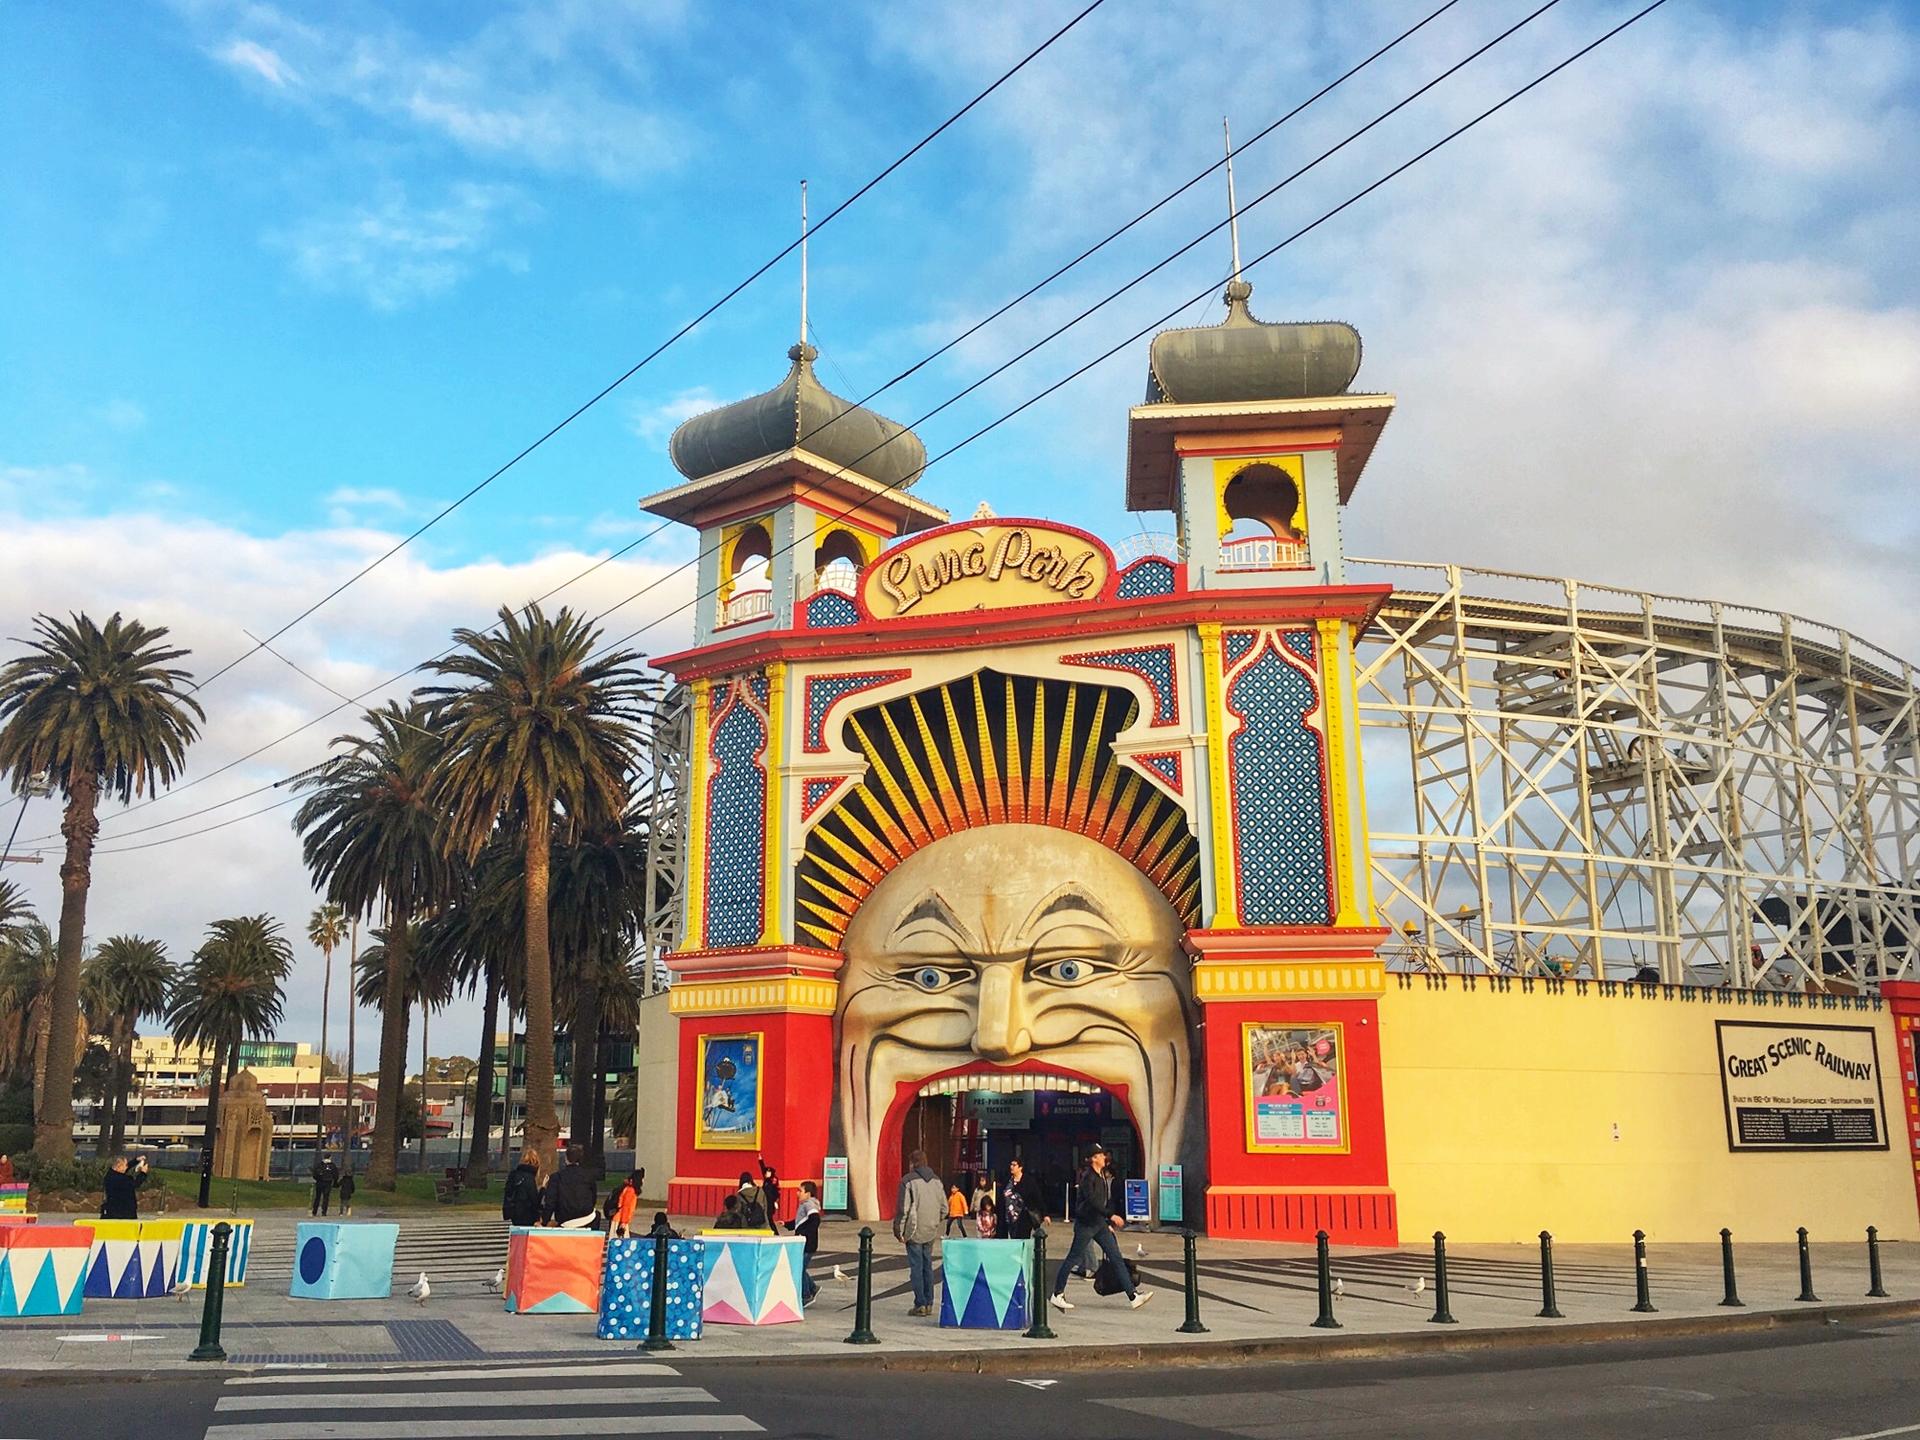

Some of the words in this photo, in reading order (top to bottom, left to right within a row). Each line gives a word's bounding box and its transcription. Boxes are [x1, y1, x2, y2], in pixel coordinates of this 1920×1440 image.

[881, 541, 986, 615] Luna
[988, 527, 1096, 598] Park
[1056, 1098, 1087, 1106] GENERAL
[986, 1106, 1011, 1114] TICKETS
[1053, 1106, 1090, 1115] ADMISSION
